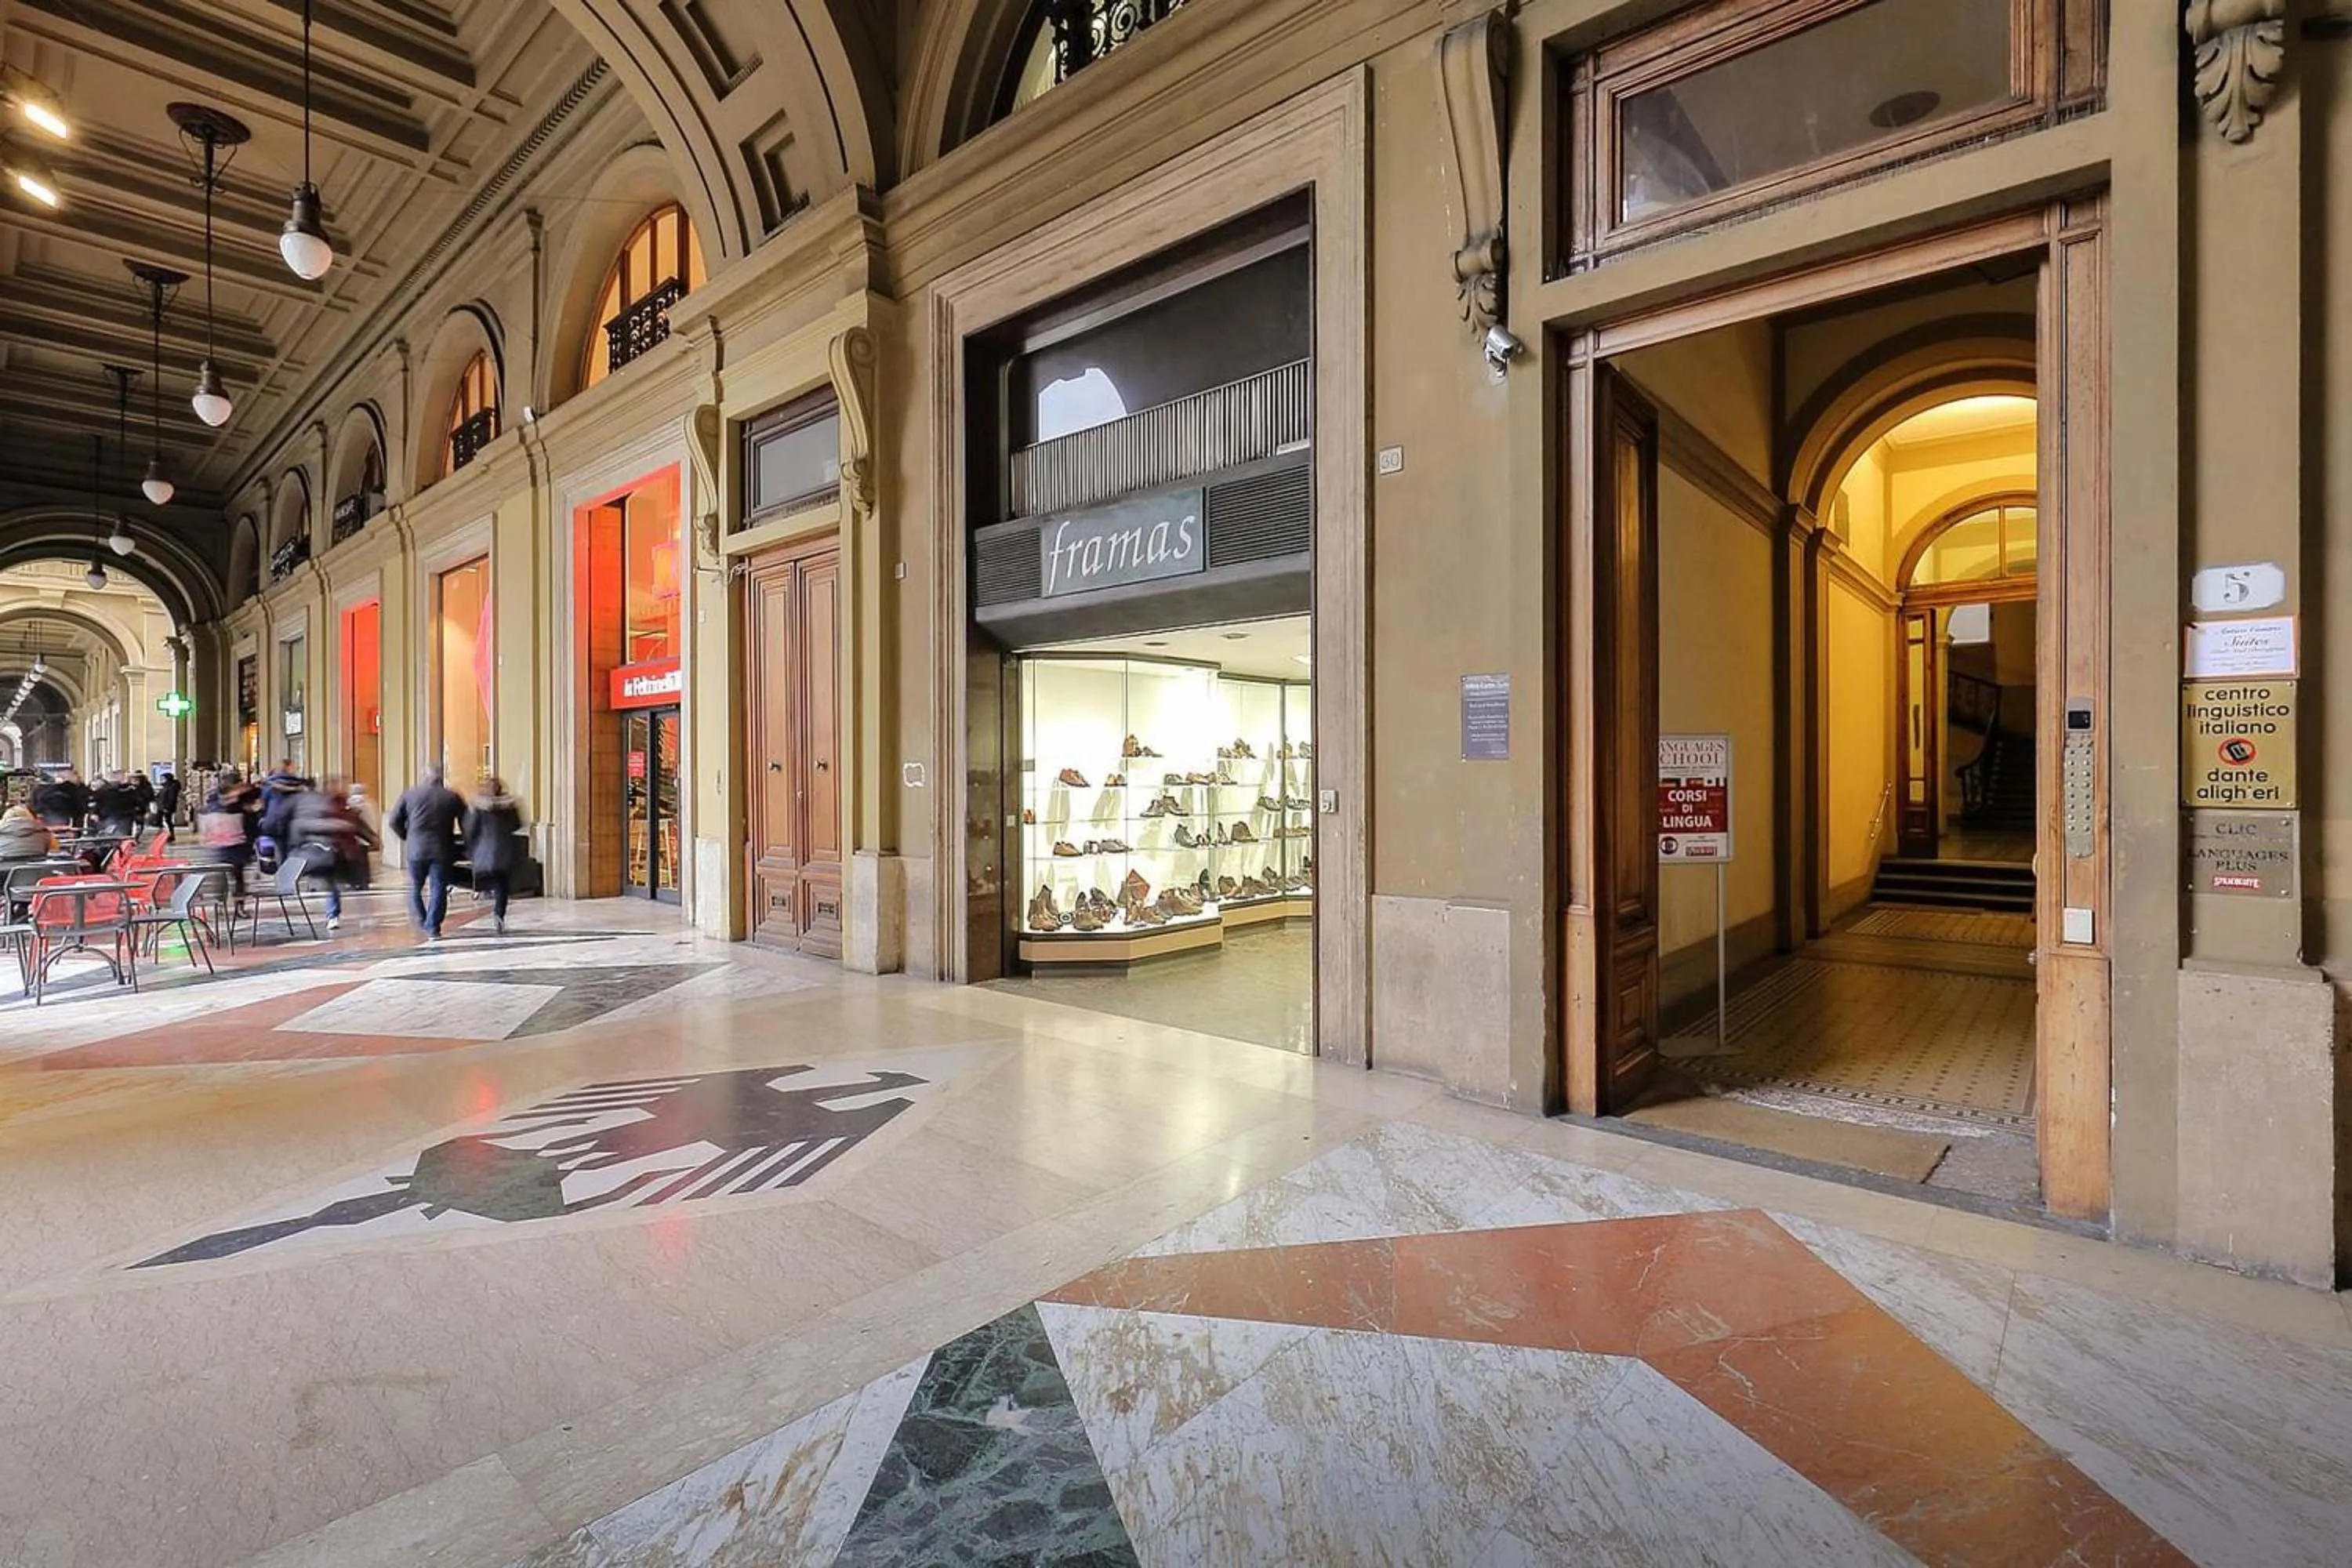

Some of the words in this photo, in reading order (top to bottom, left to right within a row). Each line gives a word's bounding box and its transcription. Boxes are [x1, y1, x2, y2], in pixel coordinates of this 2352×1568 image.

[1048, 514, 1196, 595] framas
[2223, 571, 2250, 604] 5
[2204, 687, 2270, 701] centro
[2187, 702, 2290, 720] linguistico
[2199, 720, 2277, 735] italiano
[1660, 741, 1725, 753] ANGUAGES
[1660, 753, 1722, 764] CHOOL
[2207, 768, 2269, 782] dante
[1668, 789, 1707, 802] CORSI
[2197, 785, 2279, 802] aligheri
[1682, 804, 1693, 814] DI
[1663, 815, 1713, 828] LINGUA
[2216, 823, 2256, 835] CLIC
[2216, 860, 2258, 871] PLUS
